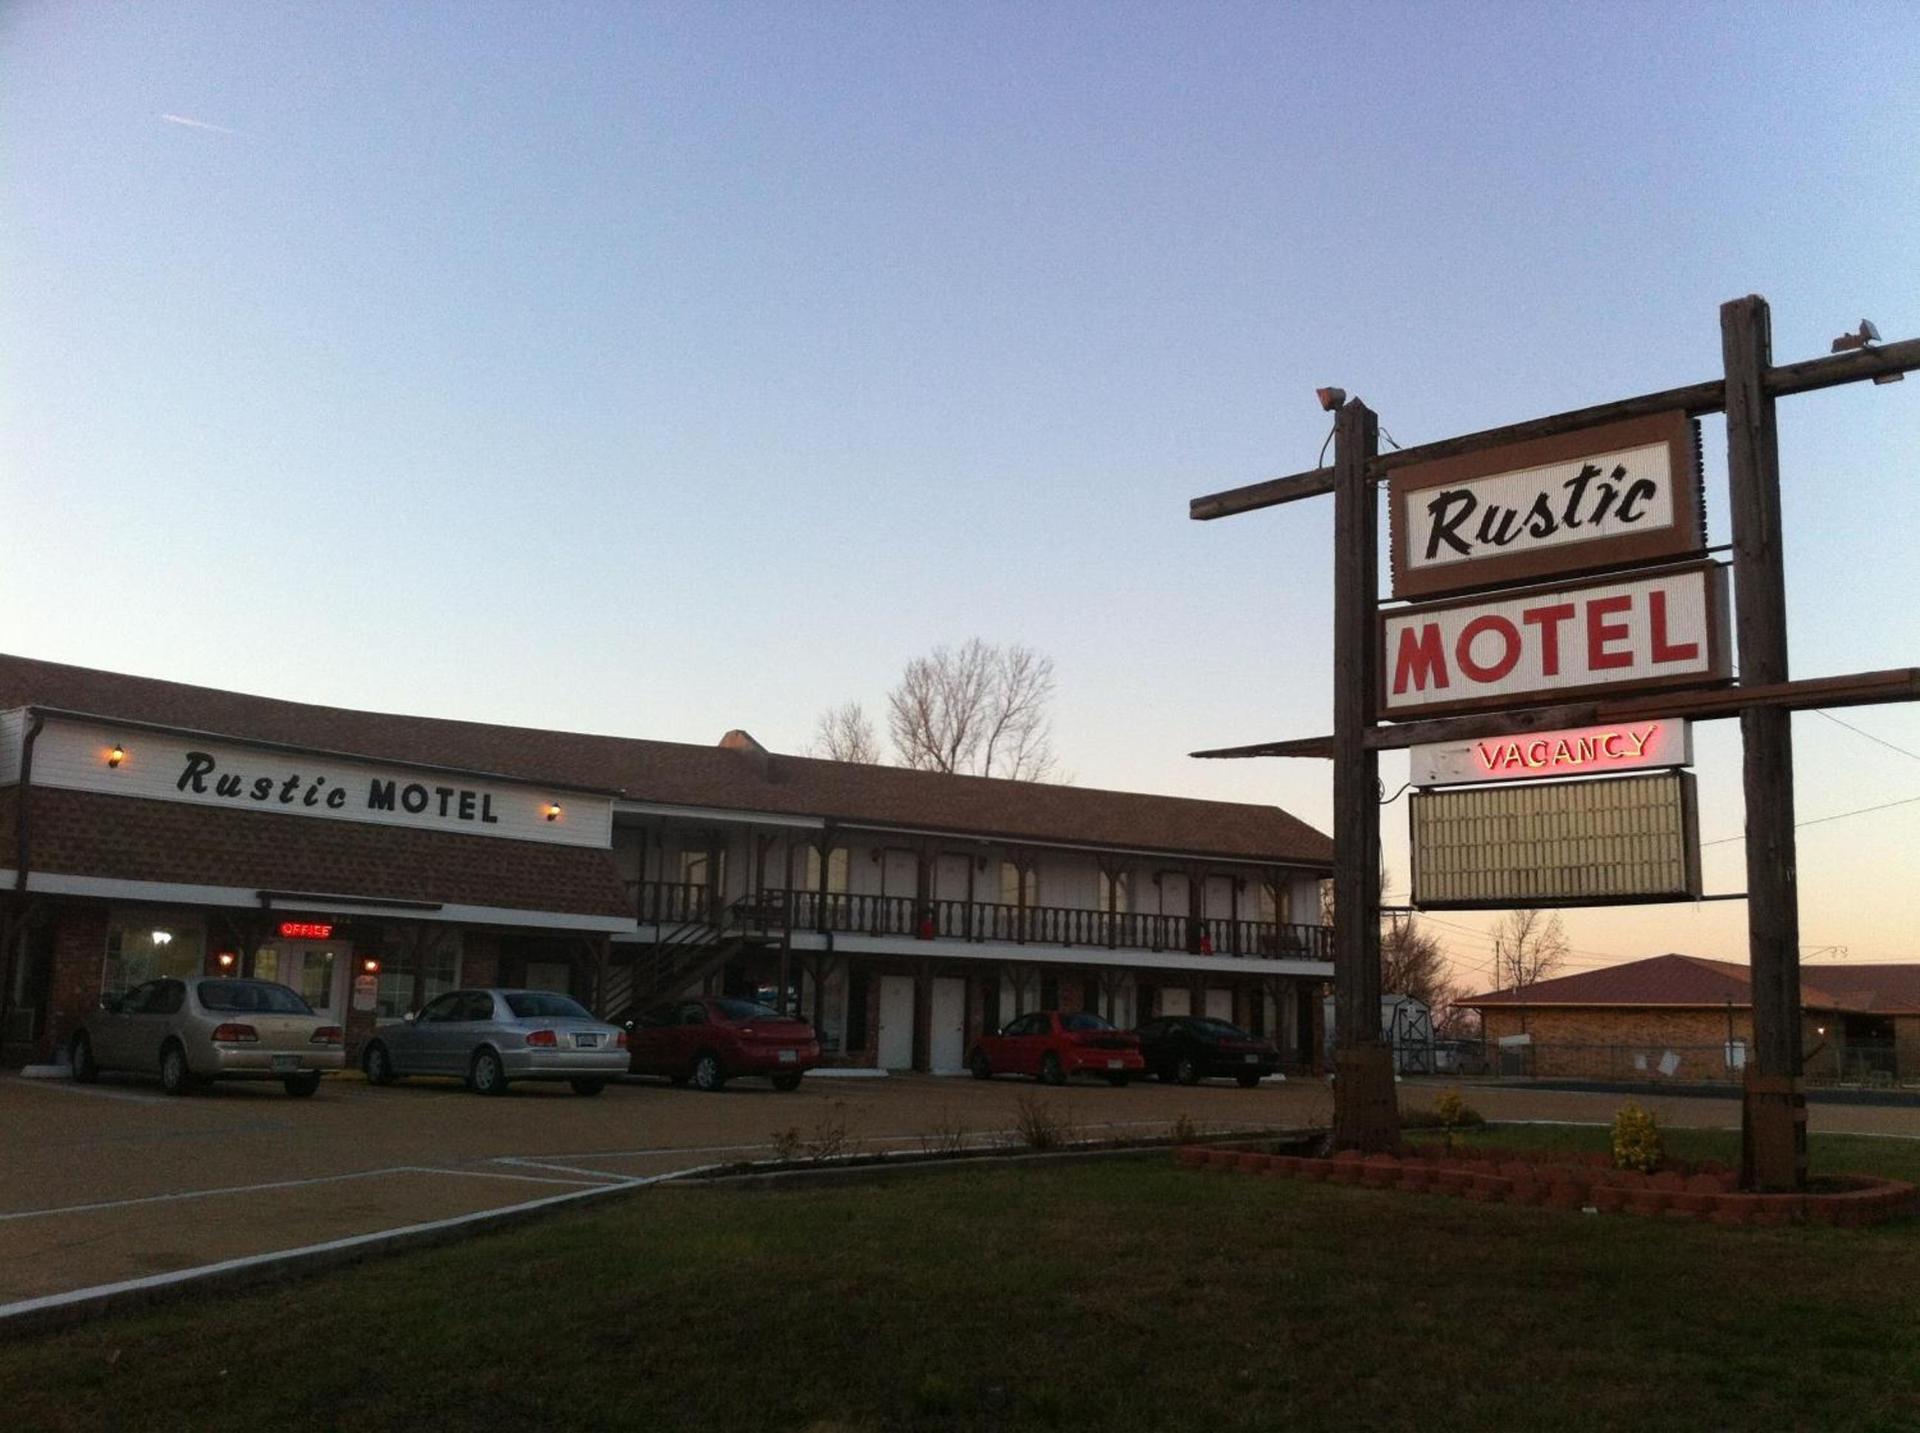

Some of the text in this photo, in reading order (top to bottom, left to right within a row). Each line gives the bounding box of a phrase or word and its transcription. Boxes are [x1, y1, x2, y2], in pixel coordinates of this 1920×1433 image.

[1425, 461, 1658, 560] Rustic
[1392, 590, 1699, 695] MOTEL
[1477, 723, 1659, 769] VACANCY
[177, 751, 499, 824] Rustic MOTEL
[281, 922, 333, 937] OFFICE
